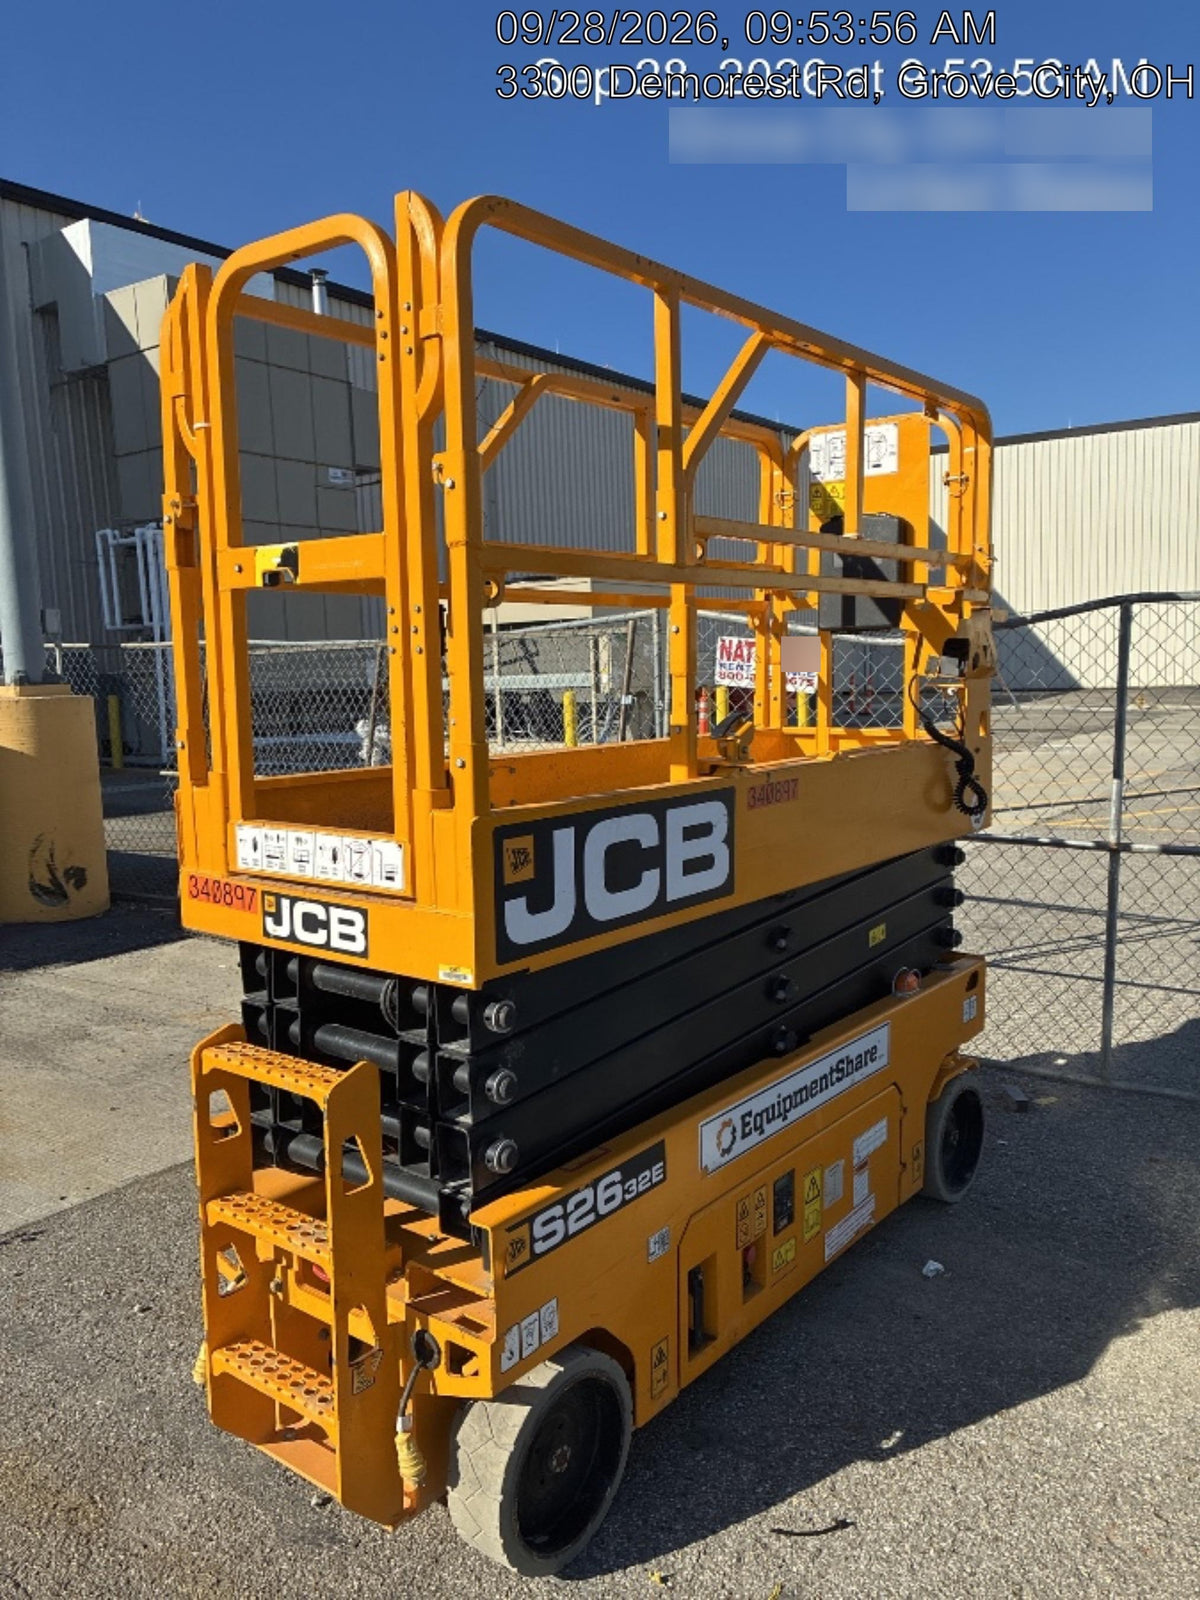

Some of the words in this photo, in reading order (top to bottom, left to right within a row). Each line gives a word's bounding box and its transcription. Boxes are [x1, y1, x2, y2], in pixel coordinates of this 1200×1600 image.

[719, 639, 756, 664] NAT
[188, 874, 257, 911] 340897
[504, 800, 730, 945] JCB
[264, 897, 367, 953] JCB
[740, 1044, 879, 1141] EquipmentShare
[532, 1170, 623, 1255] S26
